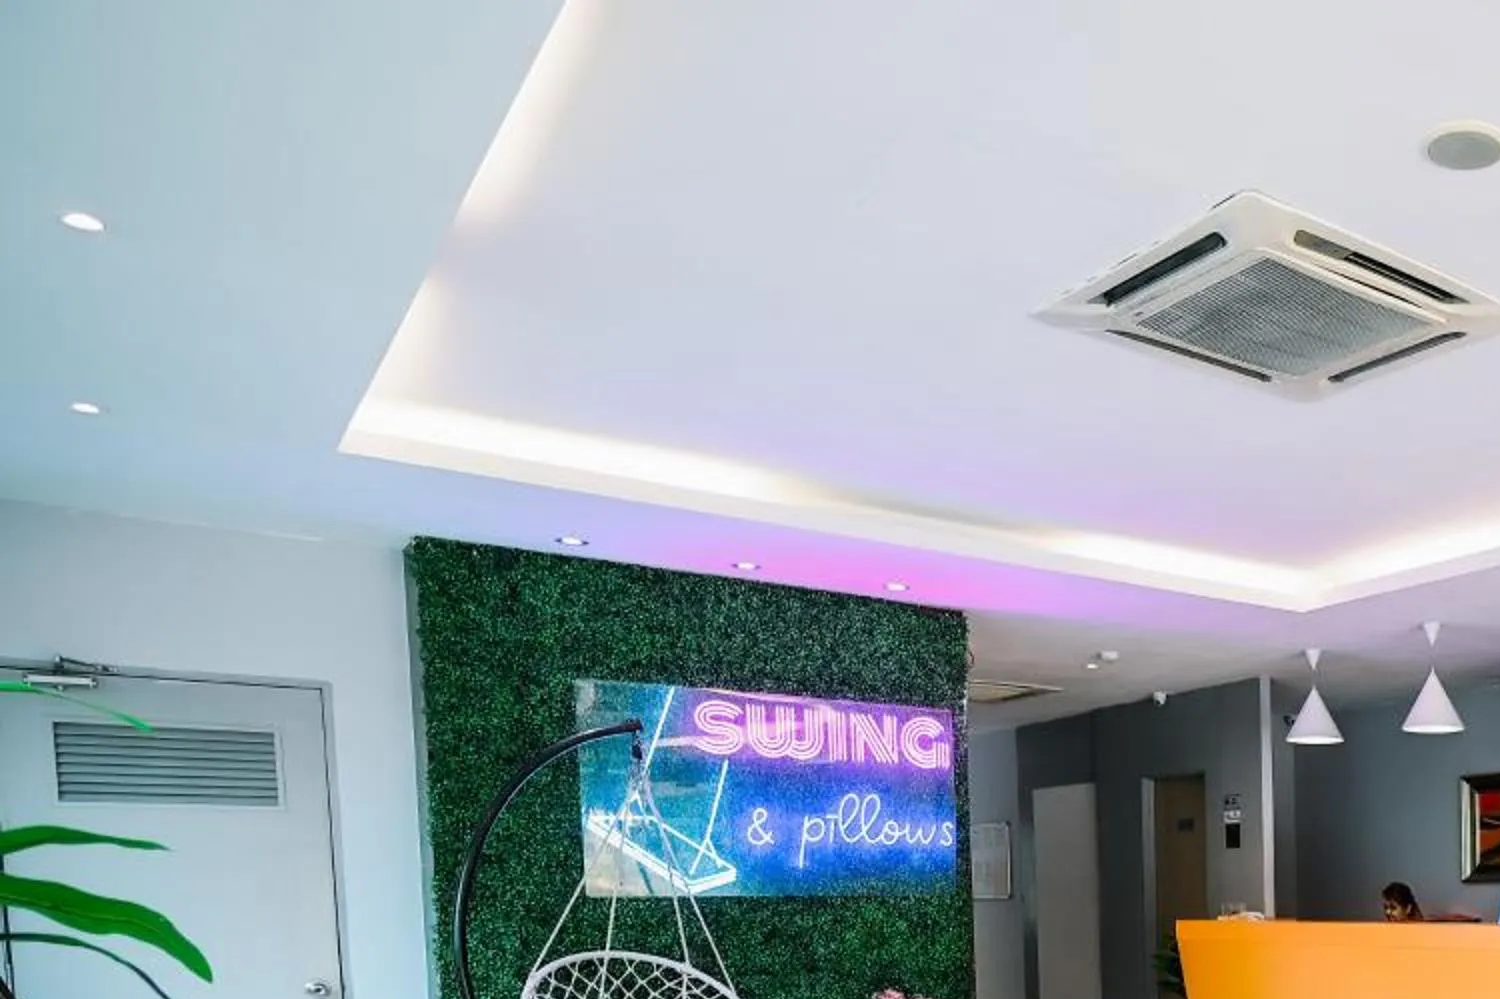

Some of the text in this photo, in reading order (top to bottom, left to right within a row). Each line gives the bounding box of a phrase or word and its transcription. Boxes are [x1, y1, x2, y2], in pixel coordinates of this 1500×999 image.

[693, 700, 951, 769] SWING
[746, 794, 955, 869] & pillows
